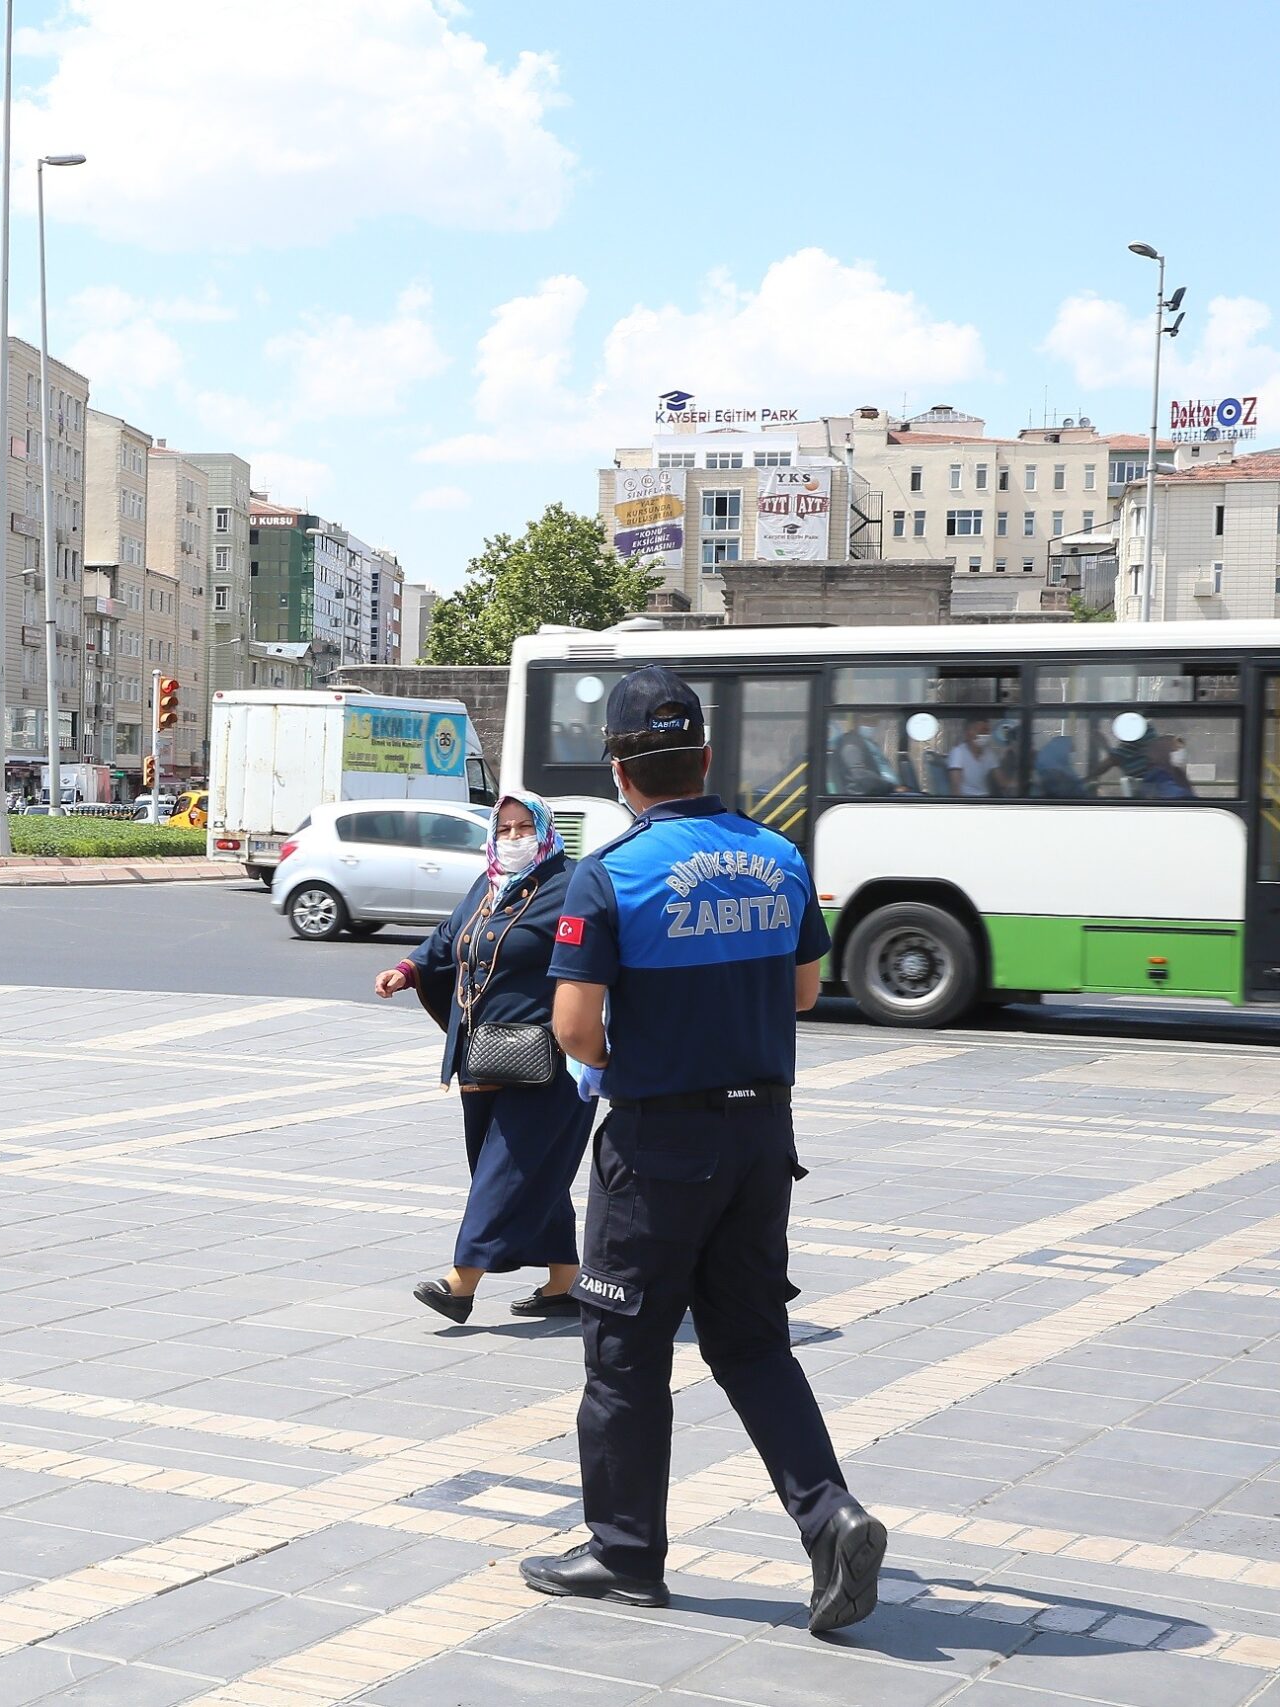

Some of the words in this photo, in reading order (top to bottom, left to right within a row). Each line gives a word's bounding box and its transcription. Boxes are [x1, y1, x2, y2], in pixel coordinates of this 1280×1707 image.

[655, 411, 710, 423] KAYSERİ
[715, 408, 756, 423] EĞİTİM
[761, 408, 798, 421] PARK
[1171, 400, 1216, 428] Doktor
[776, 473, 811, 483] YKS
[627, 485, 672, 499] SINIFLAR
[626, 504, 671, 518] KURSUNDA
[763, 497, 787, 513] TYT
[798, 496, 822, 514] AYT
[250, 515, 257, 525] Ü
[260, 515, 293, 526] KURSU
[345, 713, 372, 739] AS
[372, 716, 423, 739] EKMEK
[652, 720, 681, 728] ZABITA
[665, 850, 785, 897] BÜYÜKŞEHİR
[667, 894, 791, 938] ZABITA
[727, 1089, 756, 1098] ZABITA
[579, 1273, 626, 1302] ZABITA
